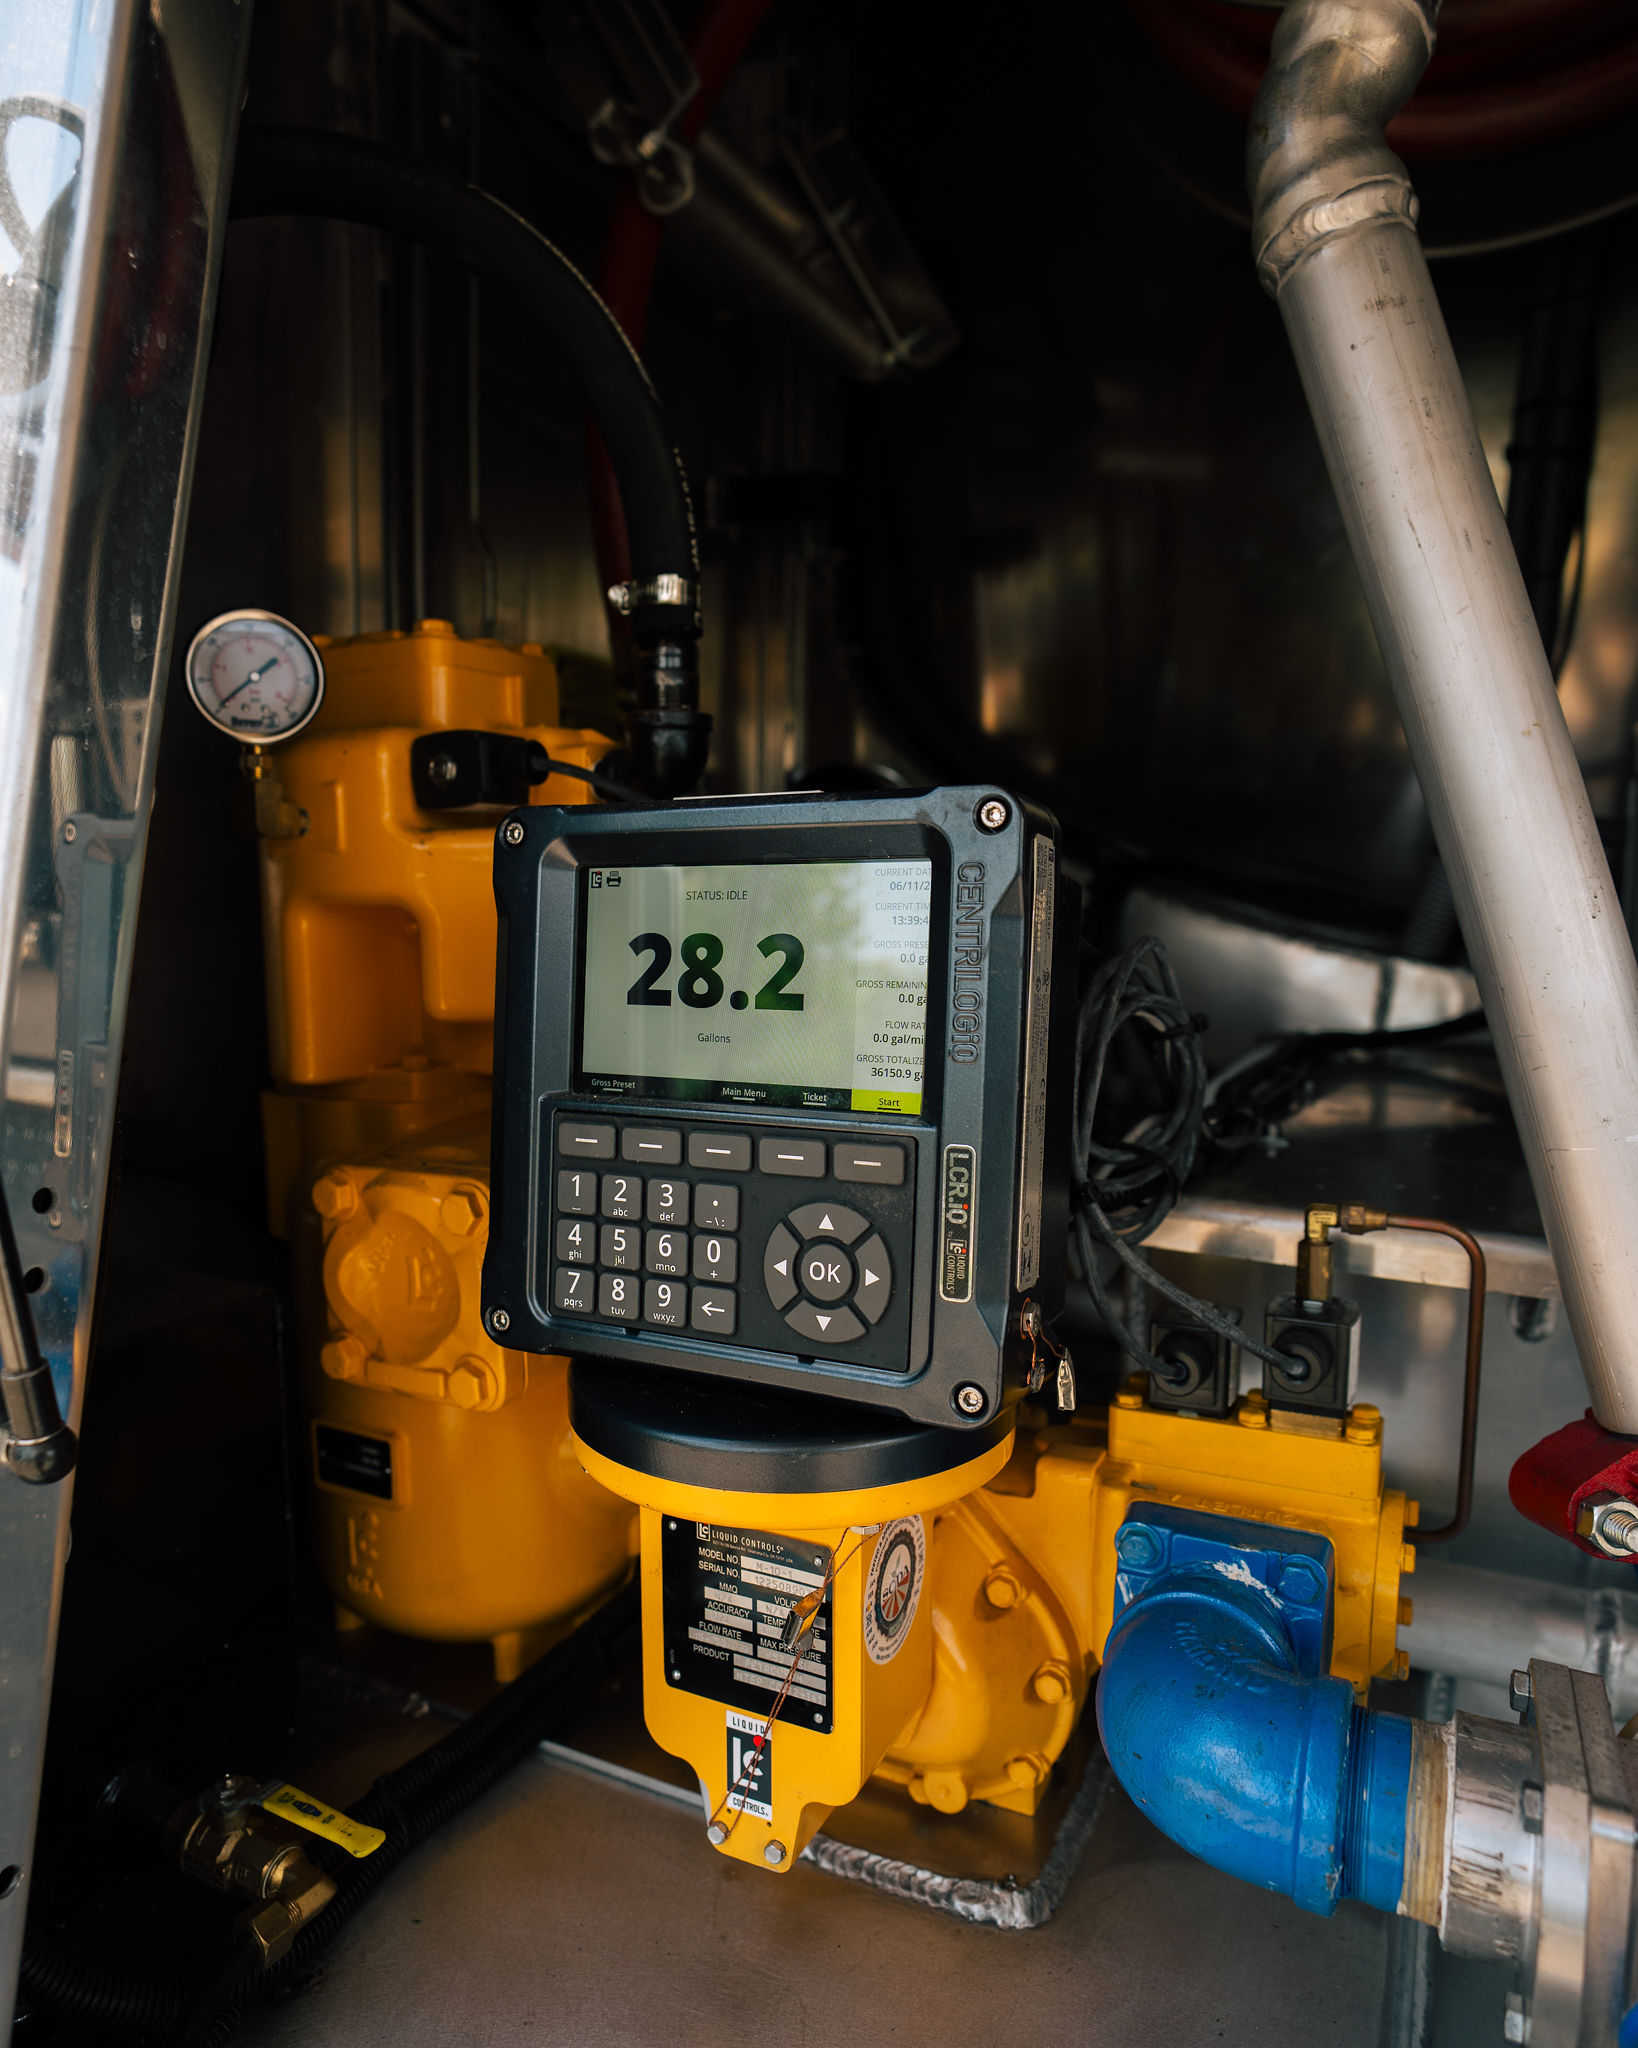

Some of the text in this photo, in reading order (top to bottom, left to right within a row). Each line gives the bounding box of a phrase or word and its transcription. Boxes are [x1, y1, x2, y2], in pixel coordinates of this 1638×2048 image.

[875, 868, 932, 877] CURRENT DAT
[889, 881, 930, 891] 06/11/2
[686, 890, 748, 901] STATUS: IDLE
[875, 902, 930, 912] CURRENT TIM
[891, 915, 929, 926] 13:39:4
[873, 940, 929, 950] GROSS PRESE
[900, 953, 929, 966] 0.0 ga
[626, 932, 805, 1012] 28.2
[855, 980, 927, 990] GROSS REMAININ
[898, 994, 928, 1006] 0.0 ga
[885, 1021, 926, 1031] FLOW RAT
[697, 1033, 731, 1043] Gallons
[873, 1033, 925, 1046] 0.0 gal/mi
[856, 1054, 924, 1066] GROSS TOTALIZE
[871, 1067, 924, 1081] 36150.9 ga
[591, 1078, 636, 1089] Gross Preset
[722, 1087, 766, 1098] Main Menu
[803, 1092, 827, 1102] Ticket
[878, 1098, 900, 1107] Start
[572, 1175, 580, 1196] 1
[614, 1179, 627, 1202] 2
[659, 1184, 673, 1207] 3
[612, 1207, 628, 1217] abc
[659, 1212, 674, 1222] def
[568, 1224, 581, 1246] 4
[613, 1229, 626, 1251] 5
[658, 1235, 672, 1257] 6
[707, 1240, 721, 1263] 0
[568, 1249, 582, 1260] ghi
[614, 1255, 625, 1266] jkl
[656, 1264, 675, 1273] mno
[809, 1262, 841, 1284] OK
[957, 1256, 966, 1280] LIQUID
[567, 1272, 580, 1294] 7
[611, 1279, 625, 1301] 8
[658, 1284, 671, 1307] 9
[564, 1297, 583, 1308] pqrs
[611, 1306, 625, 1316] tuv
[653, 1312, 676, 1323] wxyz
[712, 1530, 738, 1544] LIQUID
[699, 1547, 740, 1565] MODEL NO.
[699, 1561, 740, 1579] SERIAL NO.
[719, 1582, 738, 1594] MMQ
[755, 1575, 810, 1595] 12250890
[707, 1601, 750, 1618] ACCURACY
[699, 1621, 742, 1640] FLOW RATE
[693, 1644, 730, 1661] PRODUCT
[760, 1637, 777, 1650] MAX
[779, 1642, 822, 1663] PRESSURE
[732, 1716, 765, 1735] LIQUID
[733, 1797, 765, 1816] CONTROLS
